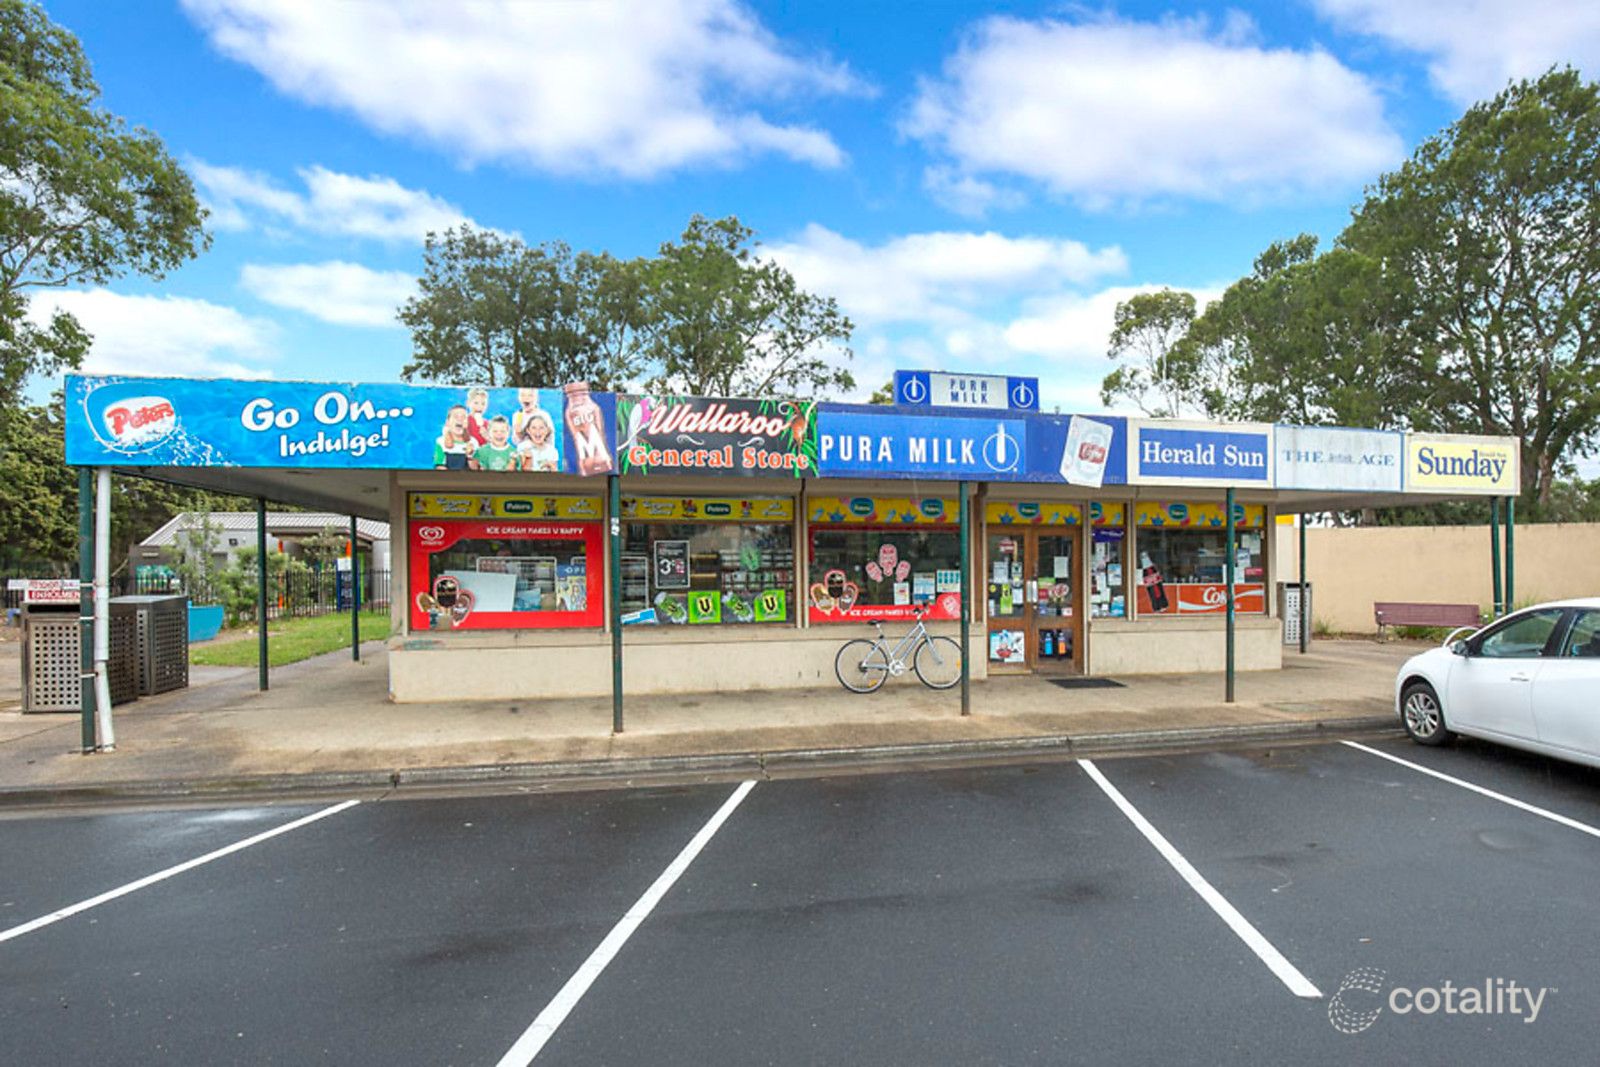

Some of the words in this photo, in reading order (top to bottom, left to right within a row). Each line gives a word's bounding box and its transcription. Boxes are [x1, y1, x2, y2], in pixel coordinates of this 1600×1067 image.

[950, 378, 988, 392] PURA
[950, 391, 988, 404] MILK
[106, 402, 174, 435] Peters
[241, 397, 300, 432] Go
[313, 391, 414, 425] On...
[648, 403, 790, 438] Wallaroo
[280, 424, 390, 457] Indulge!
[820, 434, 893, 462] PURA
[908, 437, 975, 465] MILK
[1142, 440, 1215, 466] Herald
[1223, 444, 1265, 468] Sun
[628, 445, 734, 468] General
[742, 446, 809, 469] Store
[1282, 449, 1323, 463] THE
[1356, 454, 1395, 467] AGE
[1416, 446, 1507, 483] Sunday
[699, 599, 711, 613] V
[764, 597, 776, 611] V
